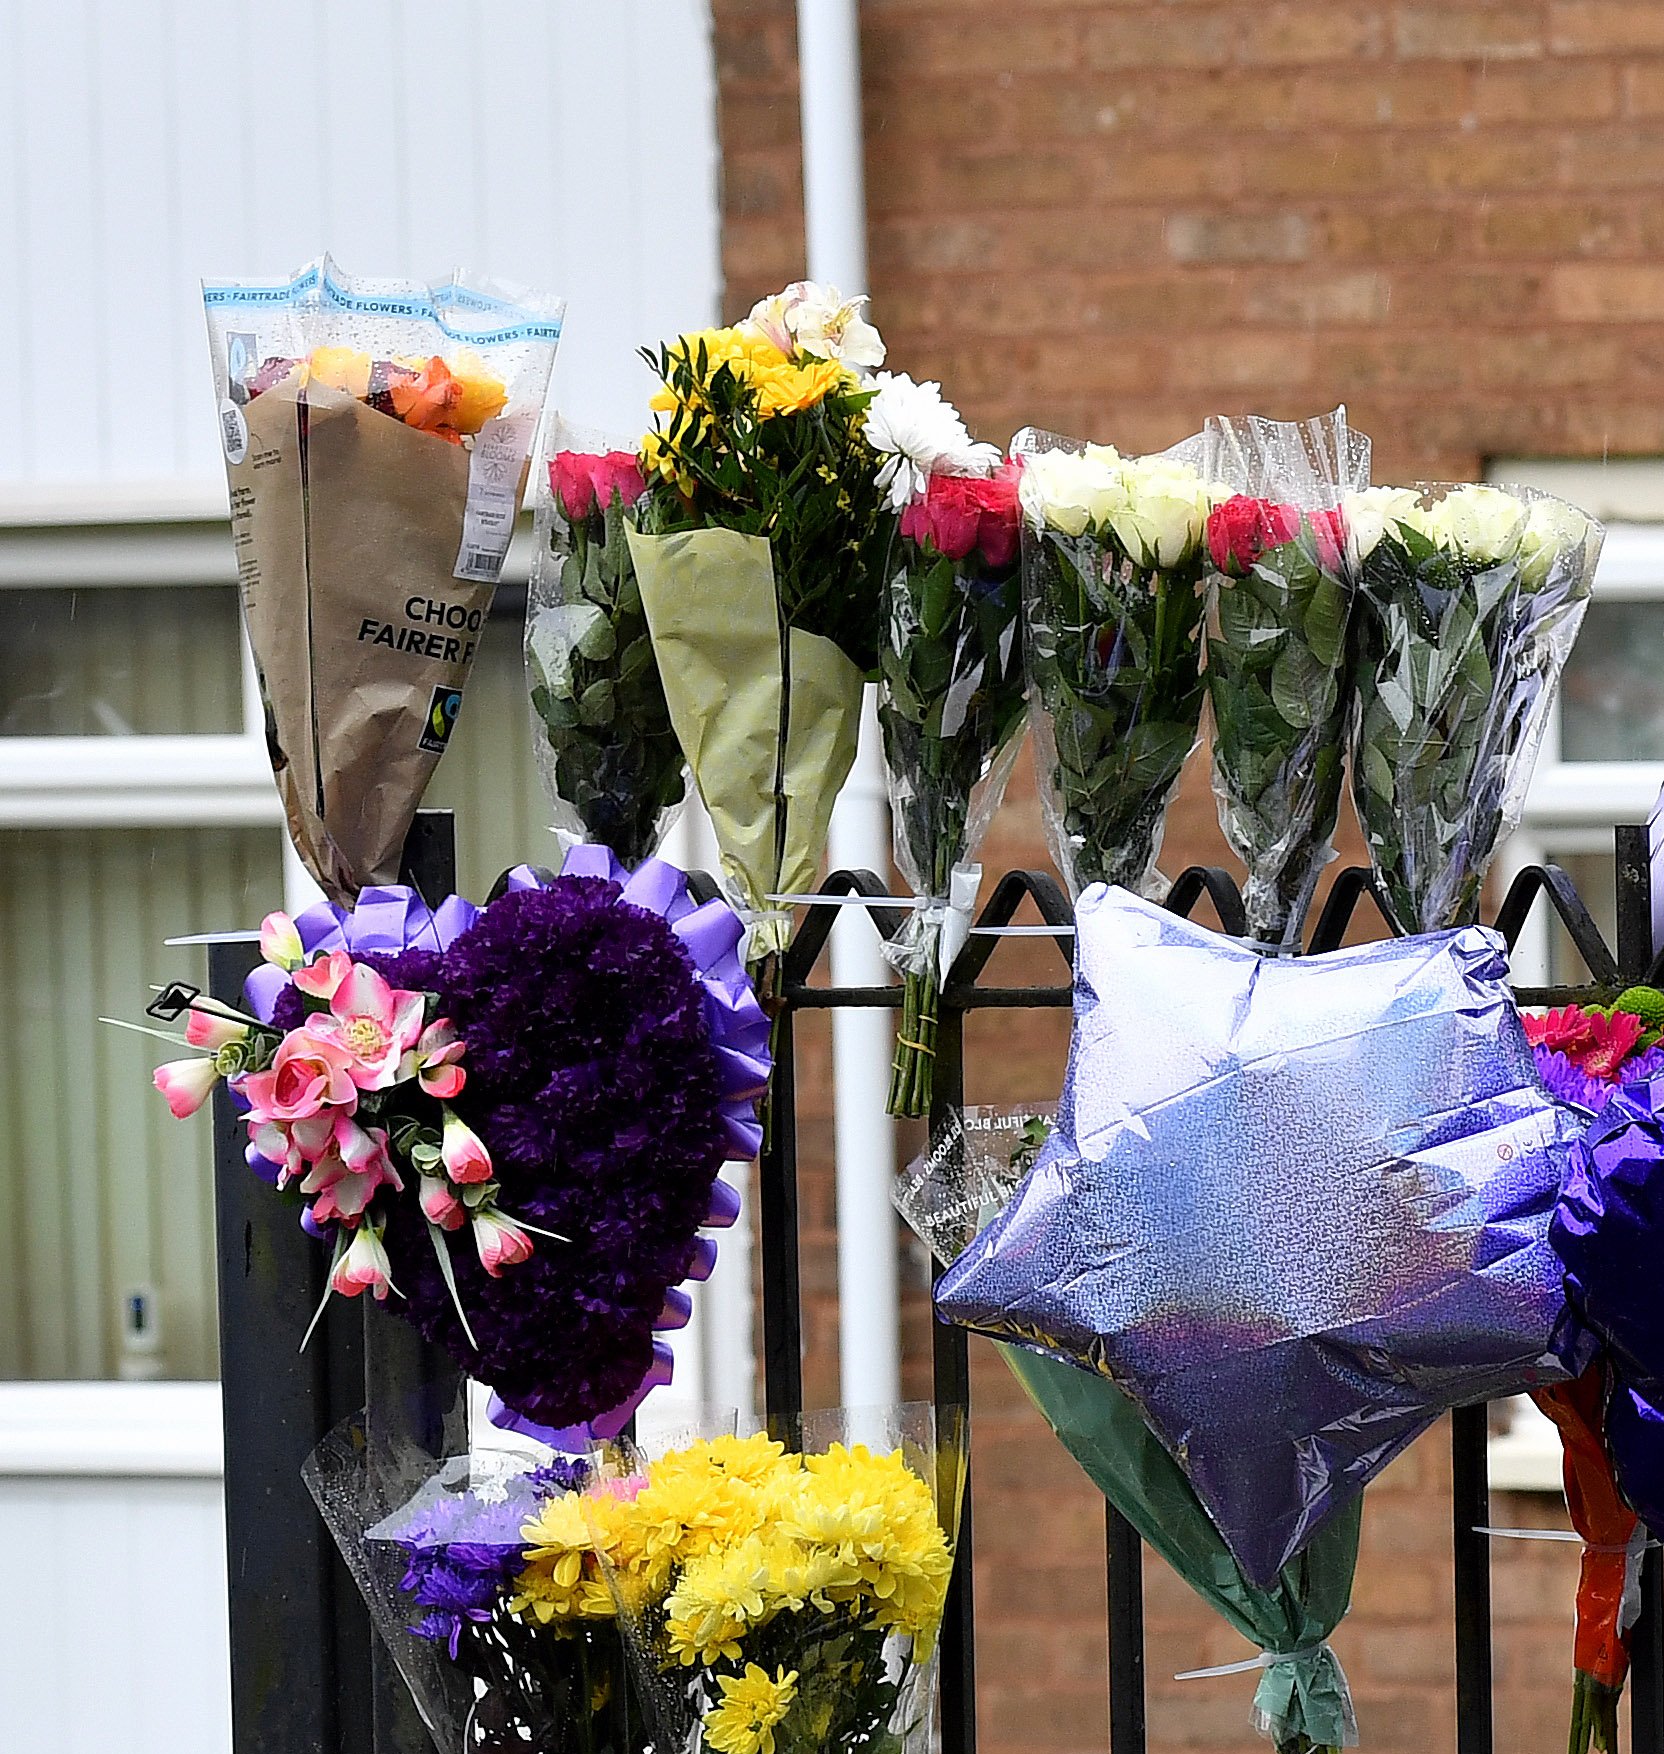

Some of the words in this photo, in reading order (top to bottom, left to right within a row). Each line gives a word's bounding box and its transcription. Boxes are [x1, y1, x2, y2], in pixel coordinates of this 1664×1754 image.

[205, 292, 225, 302] ERS
[232, 290, 290, 301] FAIRTRADE
[356, 301, 412, 315] FLOWERS
[464, 331, 519, 345] FLOWERS
[357, 618, 461, 664] FAIRER
[924, 1190, 998, 1228] BEAUTIFUL
